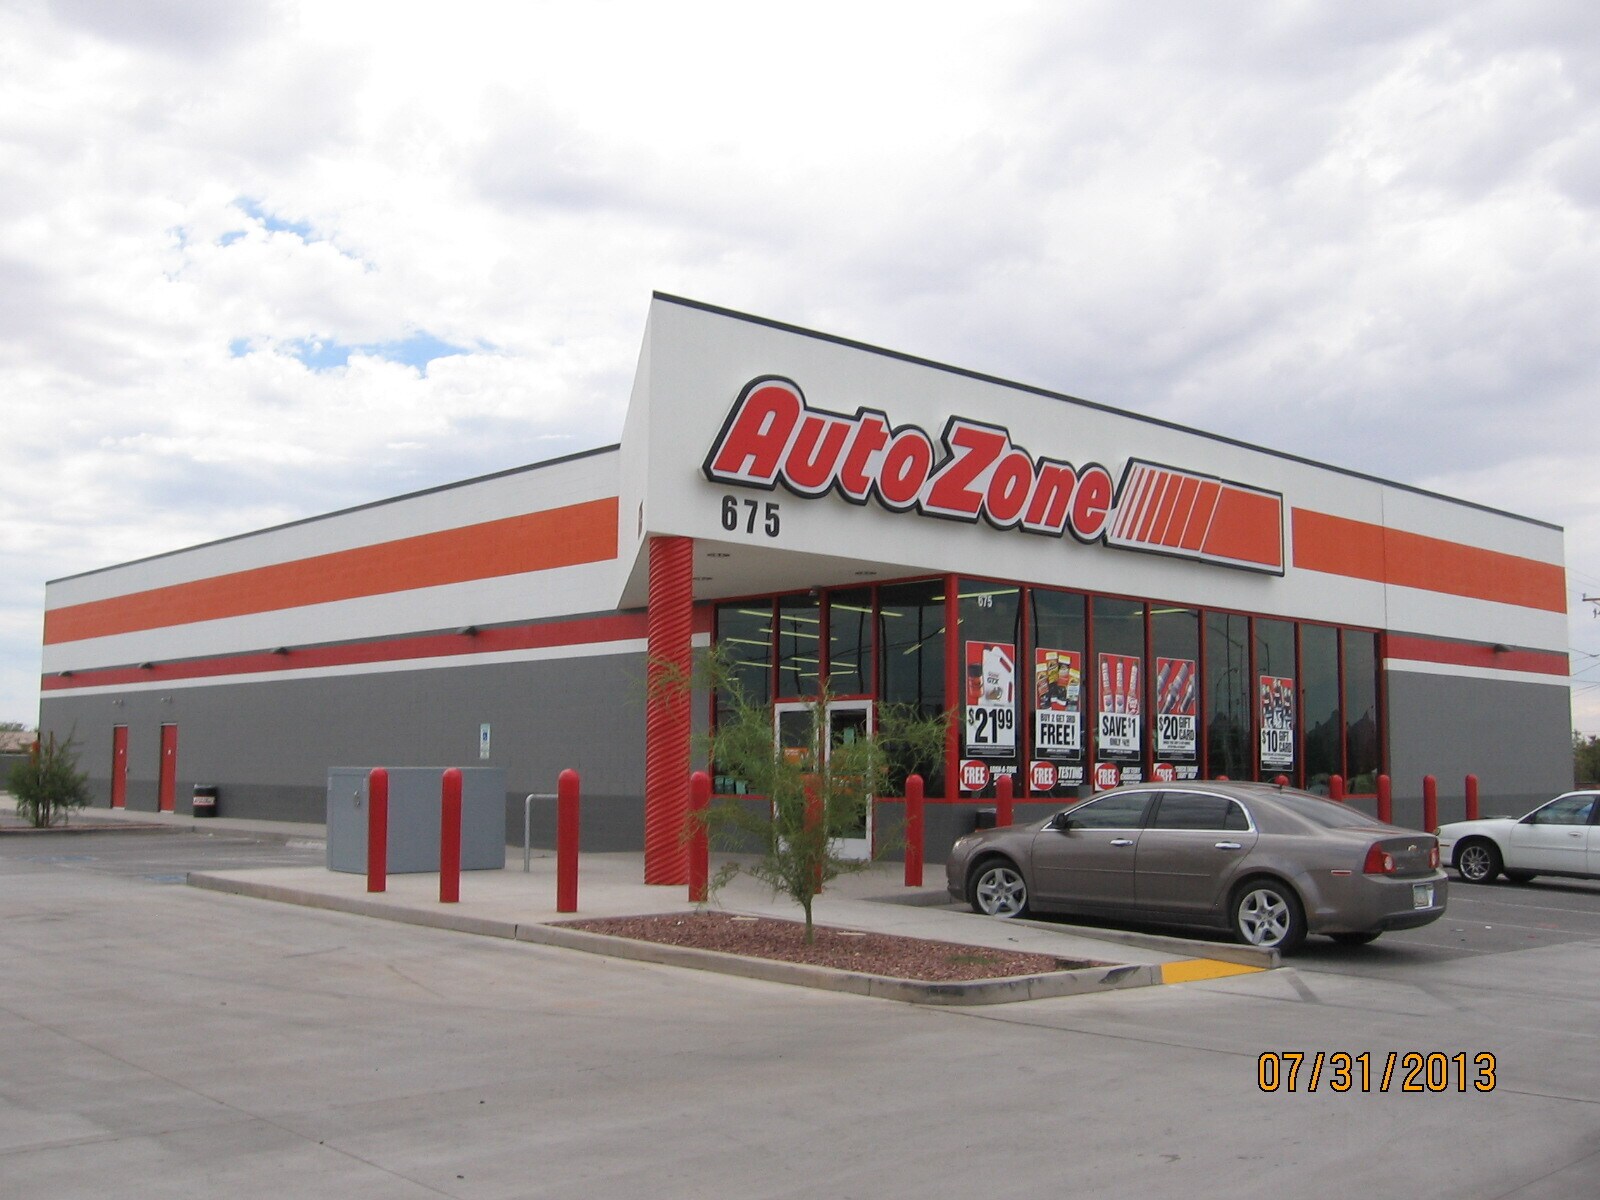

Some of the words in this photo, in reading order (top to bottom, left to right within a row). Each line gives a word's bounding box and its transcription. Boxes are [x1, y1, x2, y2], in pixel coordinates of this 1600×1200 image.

[709, 381, 1114, 538] AutoZone
[720, 494, 782, 539] 675
[978, 595, 993, 608] 675
[1040, 713, 1051, 722] BUY
[1056, 714, 1065, 723] GET
[1102, 715, 1127, 738] SAVE
[1128, 717, 1137, 738] $1
[1041, 723, 1076, 746] FREE!
[1159, 715, 1178, 741] $20
[1179, 716, 1191, 729] GIFT
[1179, 728, 1195, 741] CARD
[1262, 730, 1278, 753] $10
[1279, 730, 1290, 742] GIFT
[1279, 741, 1292, 753] CARD
[963, 766, 985, 785] FREE
[1033, 767, 1054, 785] FREE
[1058, 766, 1083, 779] TESTING
[1098, 768, 1117, 785] FREE
